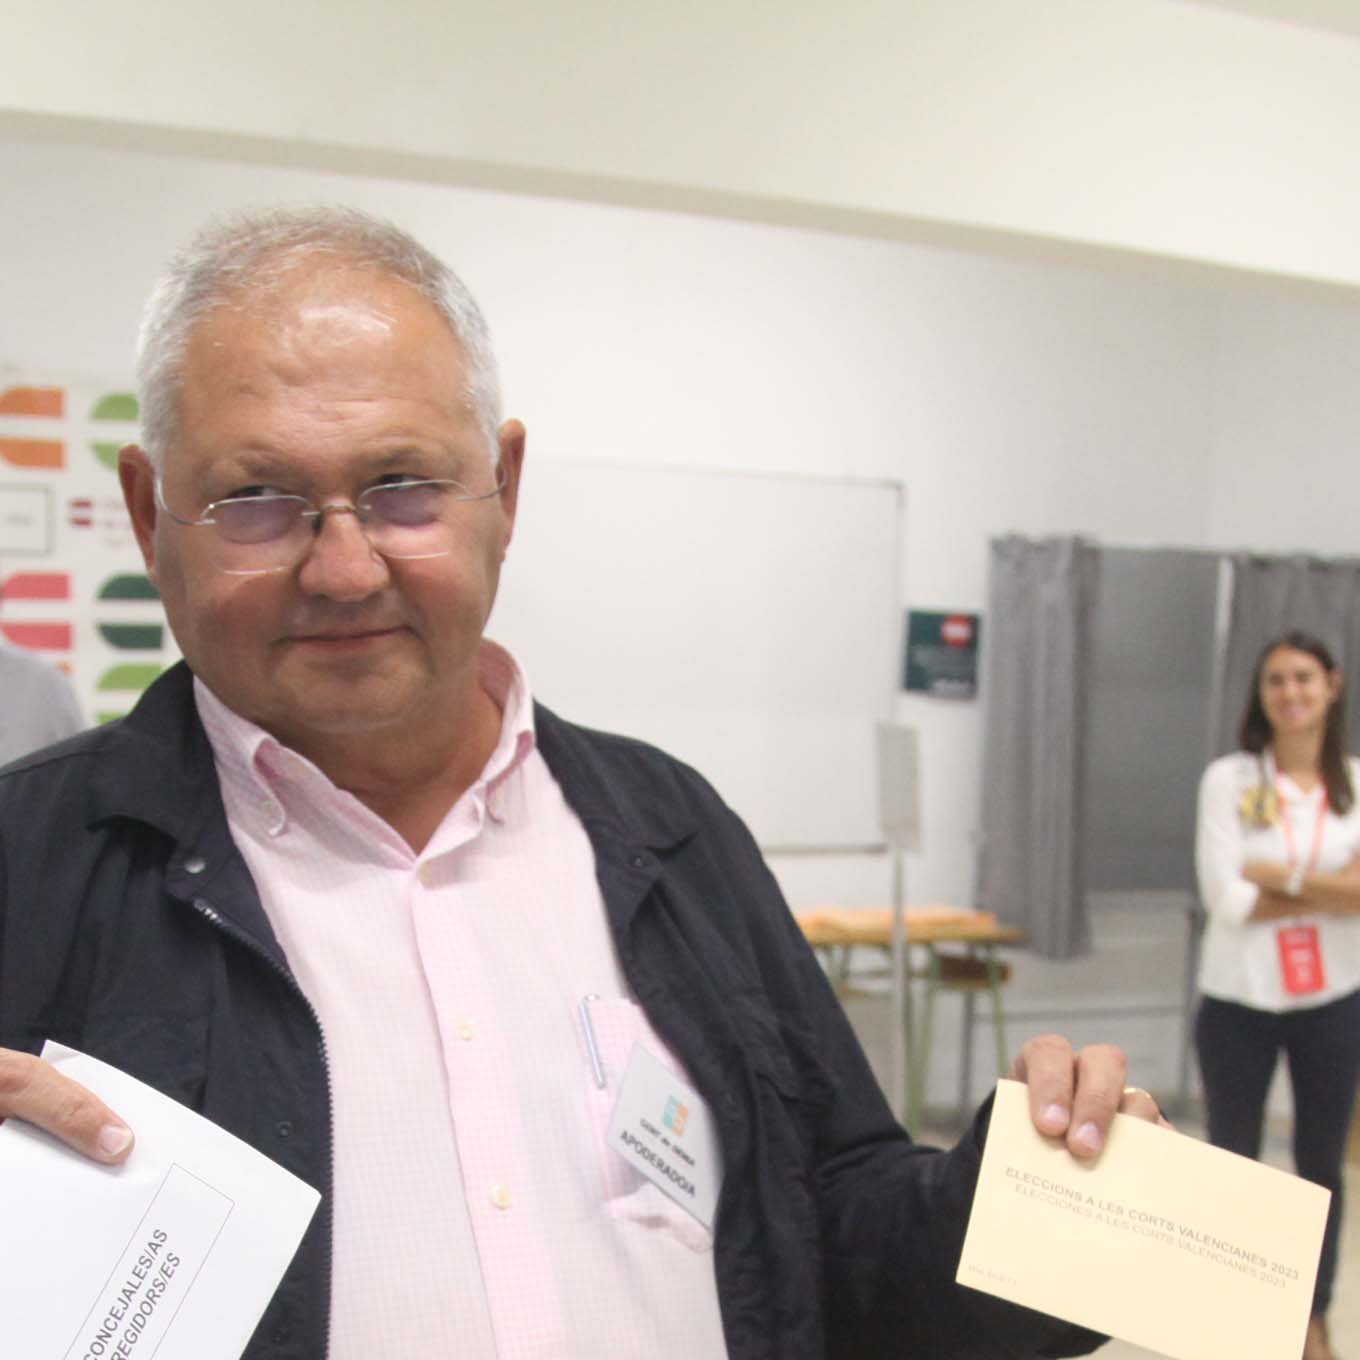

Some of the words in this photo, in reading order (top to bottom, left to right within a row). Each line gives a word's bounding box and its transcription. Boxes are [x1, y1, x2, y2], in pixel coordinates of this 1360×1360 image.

[1006, 1167, 1083, 1201] ELECCIONS
[1086, 1196, 1095, 1205] A
[1098, 1200, 1124, 1216] LES
[1129, 1208, 1175, 1232] CORTS
[1179, 1224, 1268, 1268] VALENCIANES
[1271, 1262, 1299, 1280] 2023
